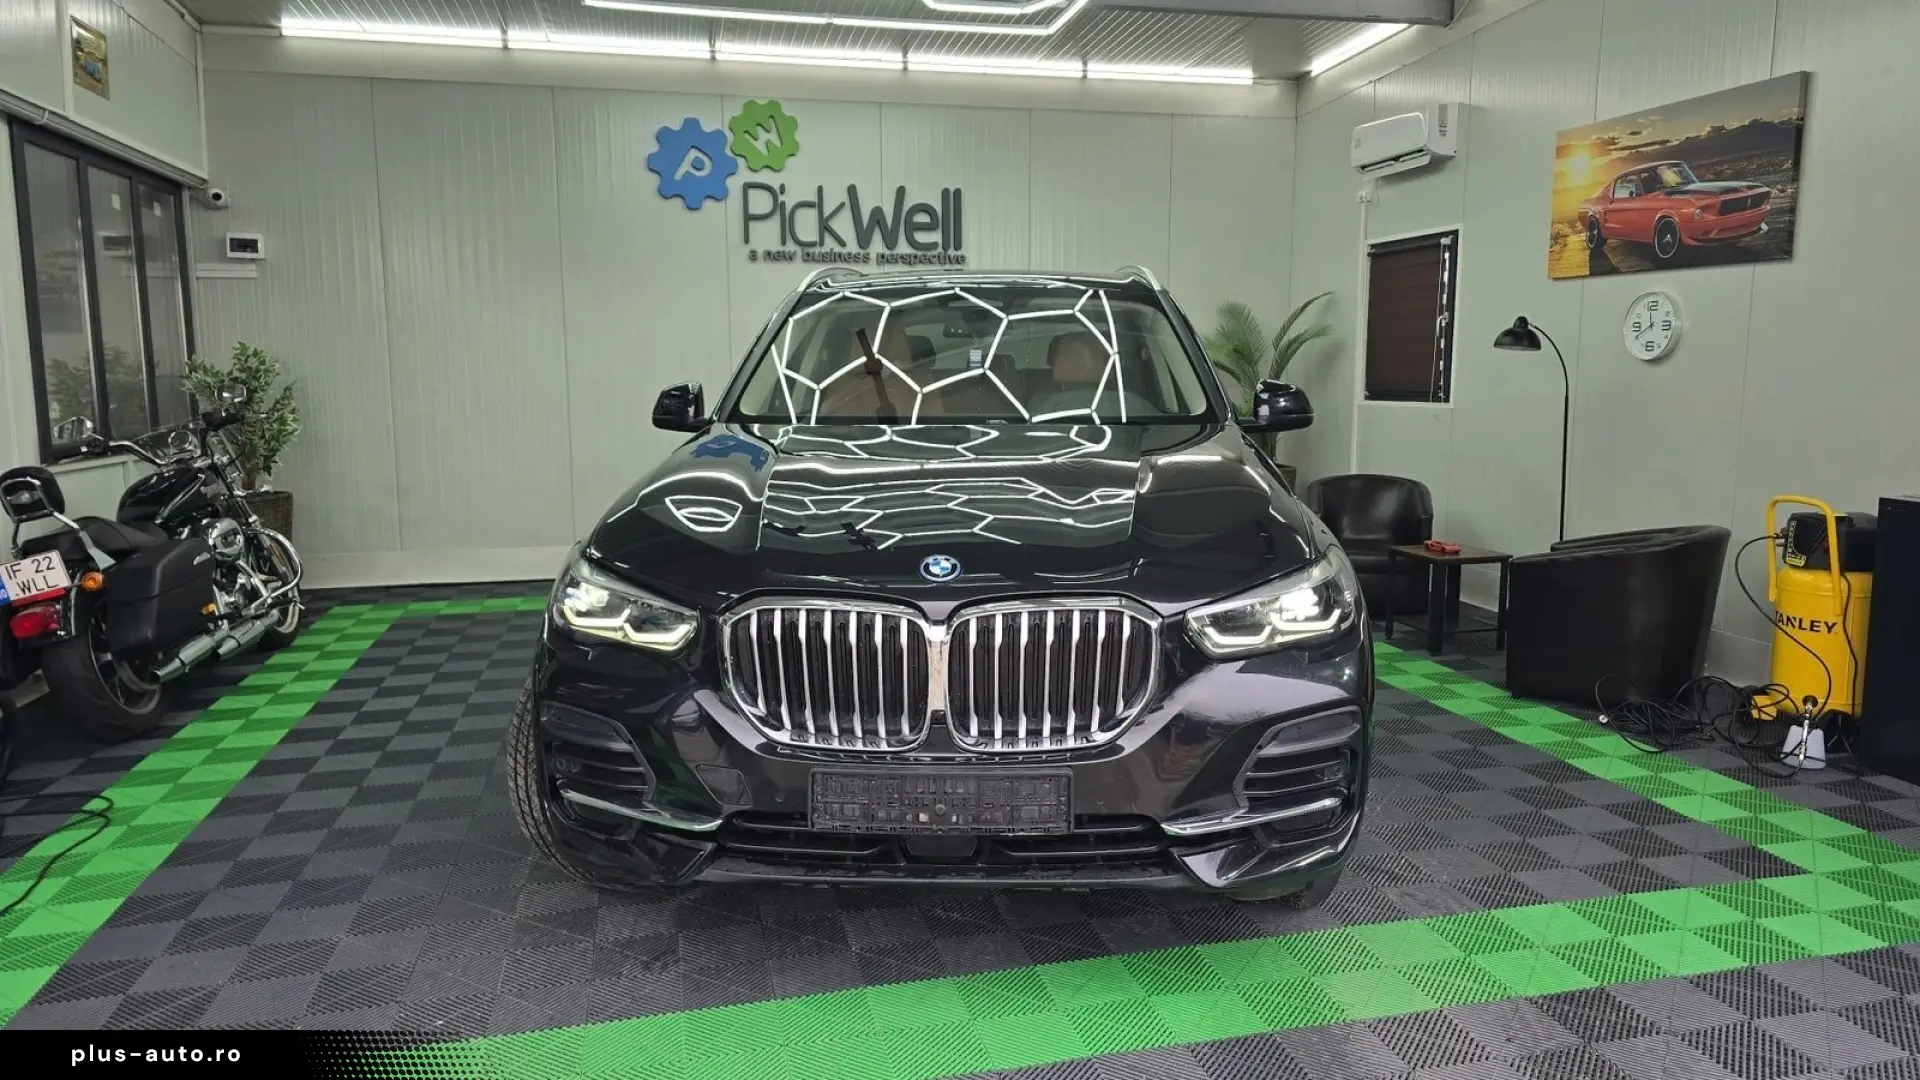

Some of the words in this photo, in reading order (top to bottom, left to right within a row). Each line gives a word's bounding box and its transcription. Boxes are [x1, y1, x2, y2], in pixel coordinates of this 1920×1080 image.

[743, 115, 783, 155] W
[674, 145, 712, 180] P
[743, 181, 963, 250] PickWell
[749, 249, 758, 261] a
[763, 249, 796, 262] new
[802, 248, 870, 264] business
[876, 250, 967, 266] perspective
[1632, 322, 1641, 332] 9
[1662, 320, 1671, 331] 3
[1645, 341, 1655, 352] 6
[5, 563, 21, 580] IF
[31, 556, 55, 573] 22
[16, 575, 60, 595] WLL
[1775, 610, 1838, 634] TANLEY
